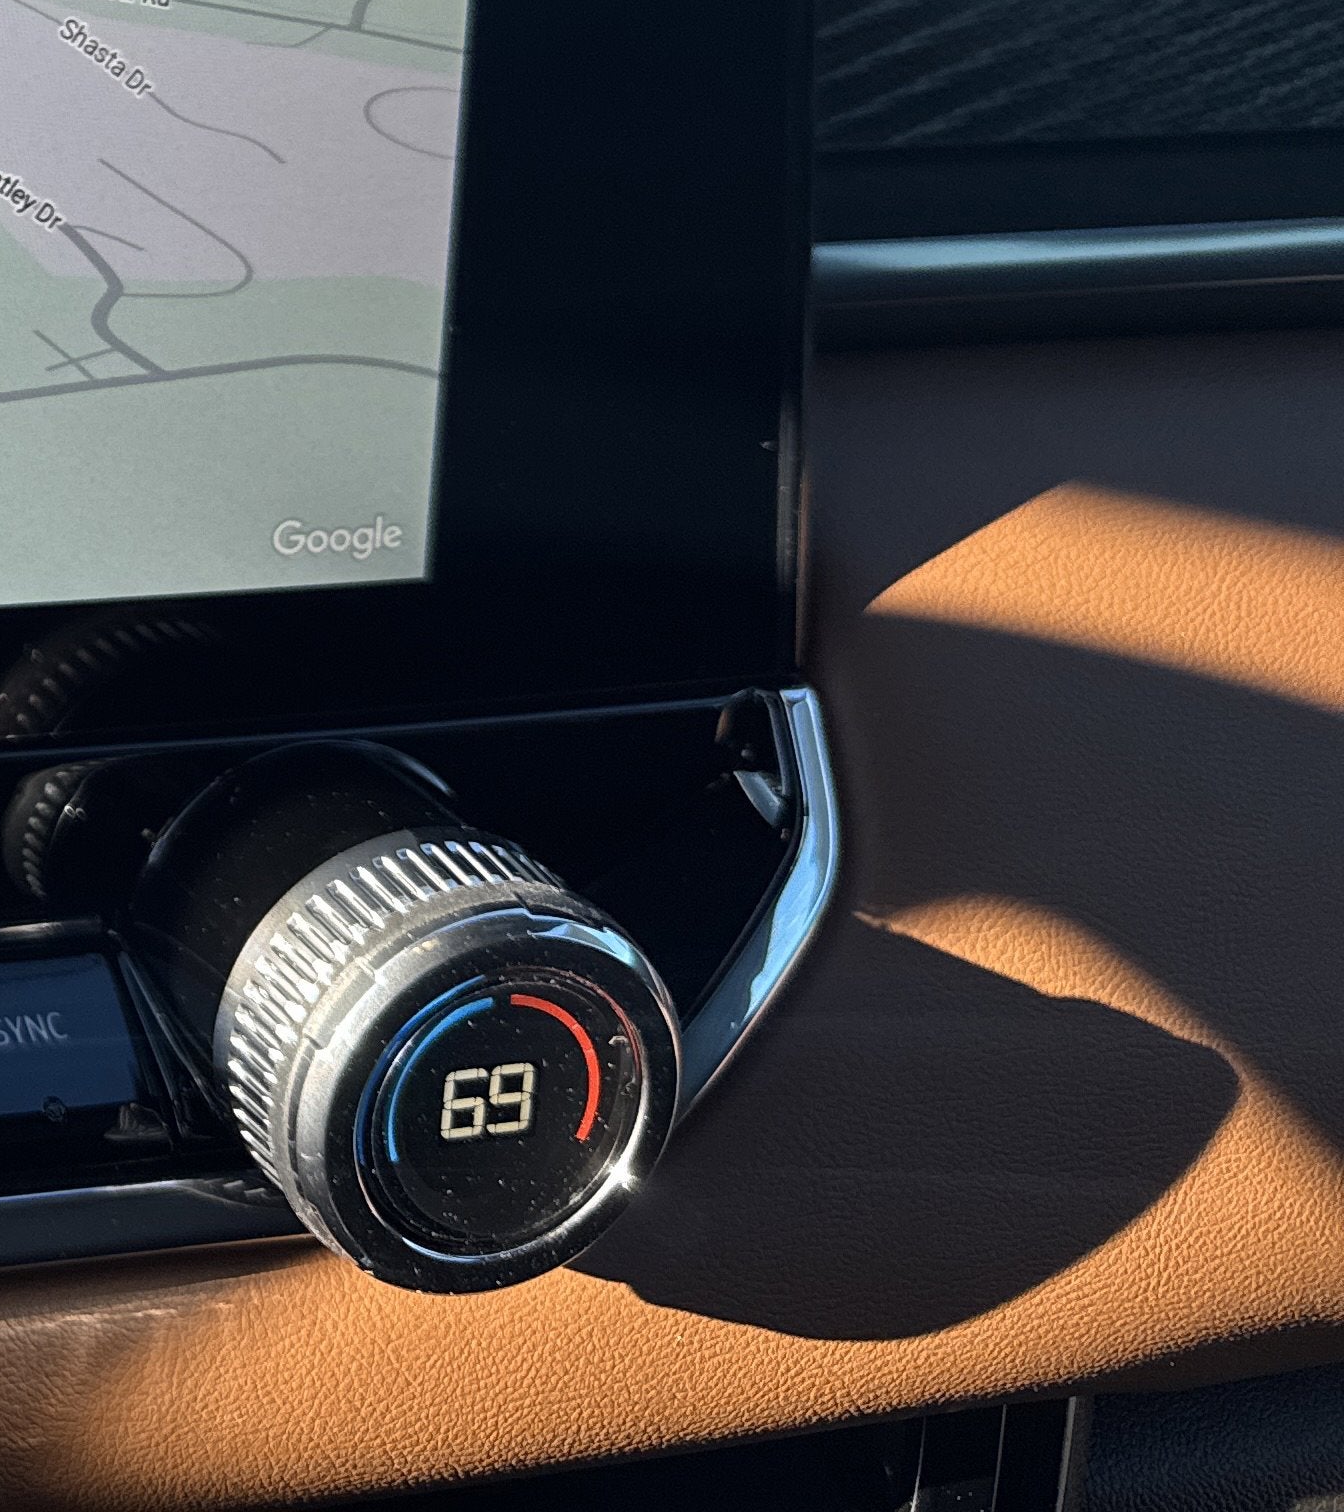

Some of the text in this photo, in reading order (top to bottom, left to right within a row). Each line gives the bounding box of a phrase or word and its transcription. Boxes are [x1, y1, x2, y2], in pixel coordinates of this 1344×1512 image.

[60, 19, 151, 95] Shasta Dr
[35, 202, 62, 229] Dr
[273, 516, 403, 559] Google
[440, 1062, 537, 1141] 69
